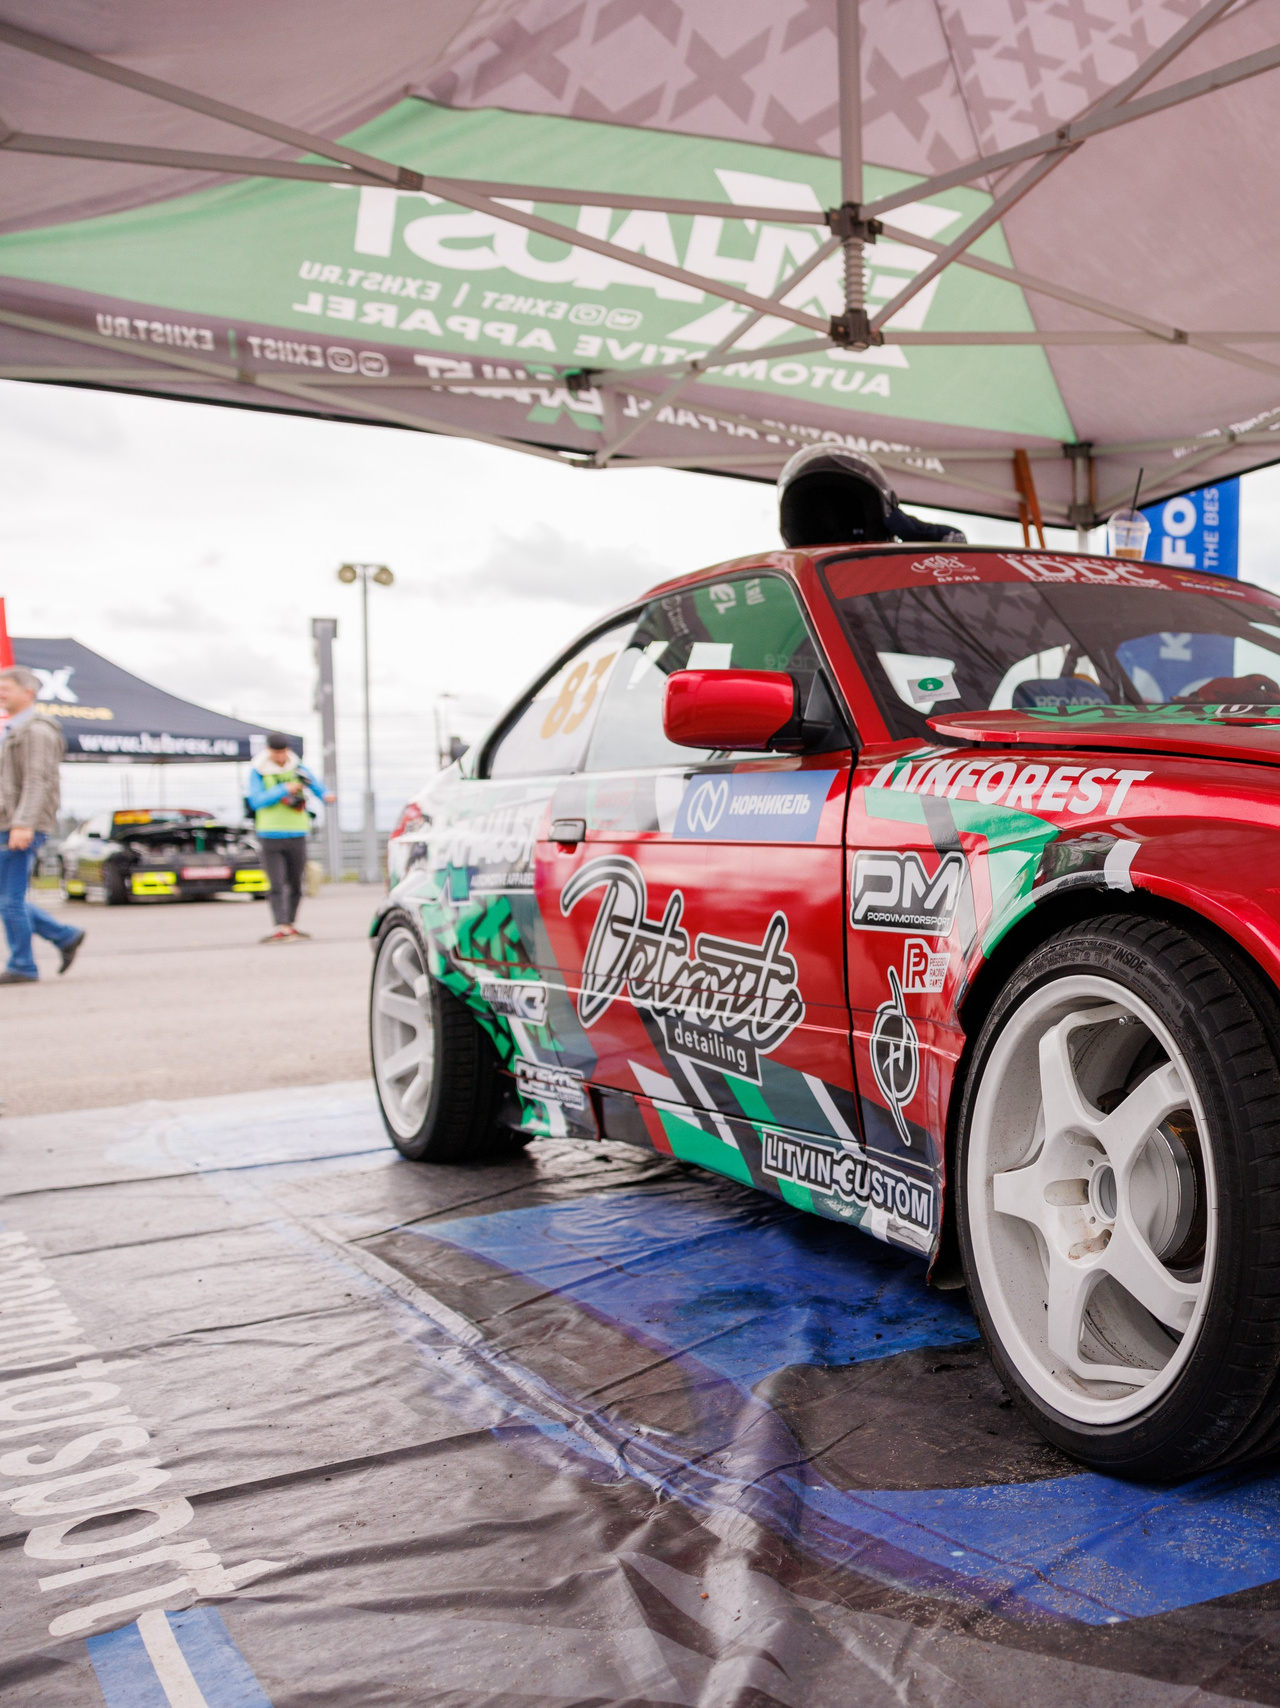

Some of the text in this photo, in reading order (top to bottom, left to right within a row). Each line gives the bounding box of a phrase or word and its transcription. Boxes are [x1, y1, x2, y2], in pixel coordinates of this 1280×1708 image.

[1203, 486, 1220, 568] THE BES
[1004, 558, 1161, 585] IDDC
[540, 650, 619, 740] 83
[728, 793, 812, 816] НОРНИКЕЛЬ
[853, 859, 960, 920] PM
[866, 911, 951, 927] POPOVMOTORSPORT
[560, 854, 804, 1053] Detroit
[1112, 947, 1147, 975] INSIDE
[673, 1025, 748, 1070] detailing
